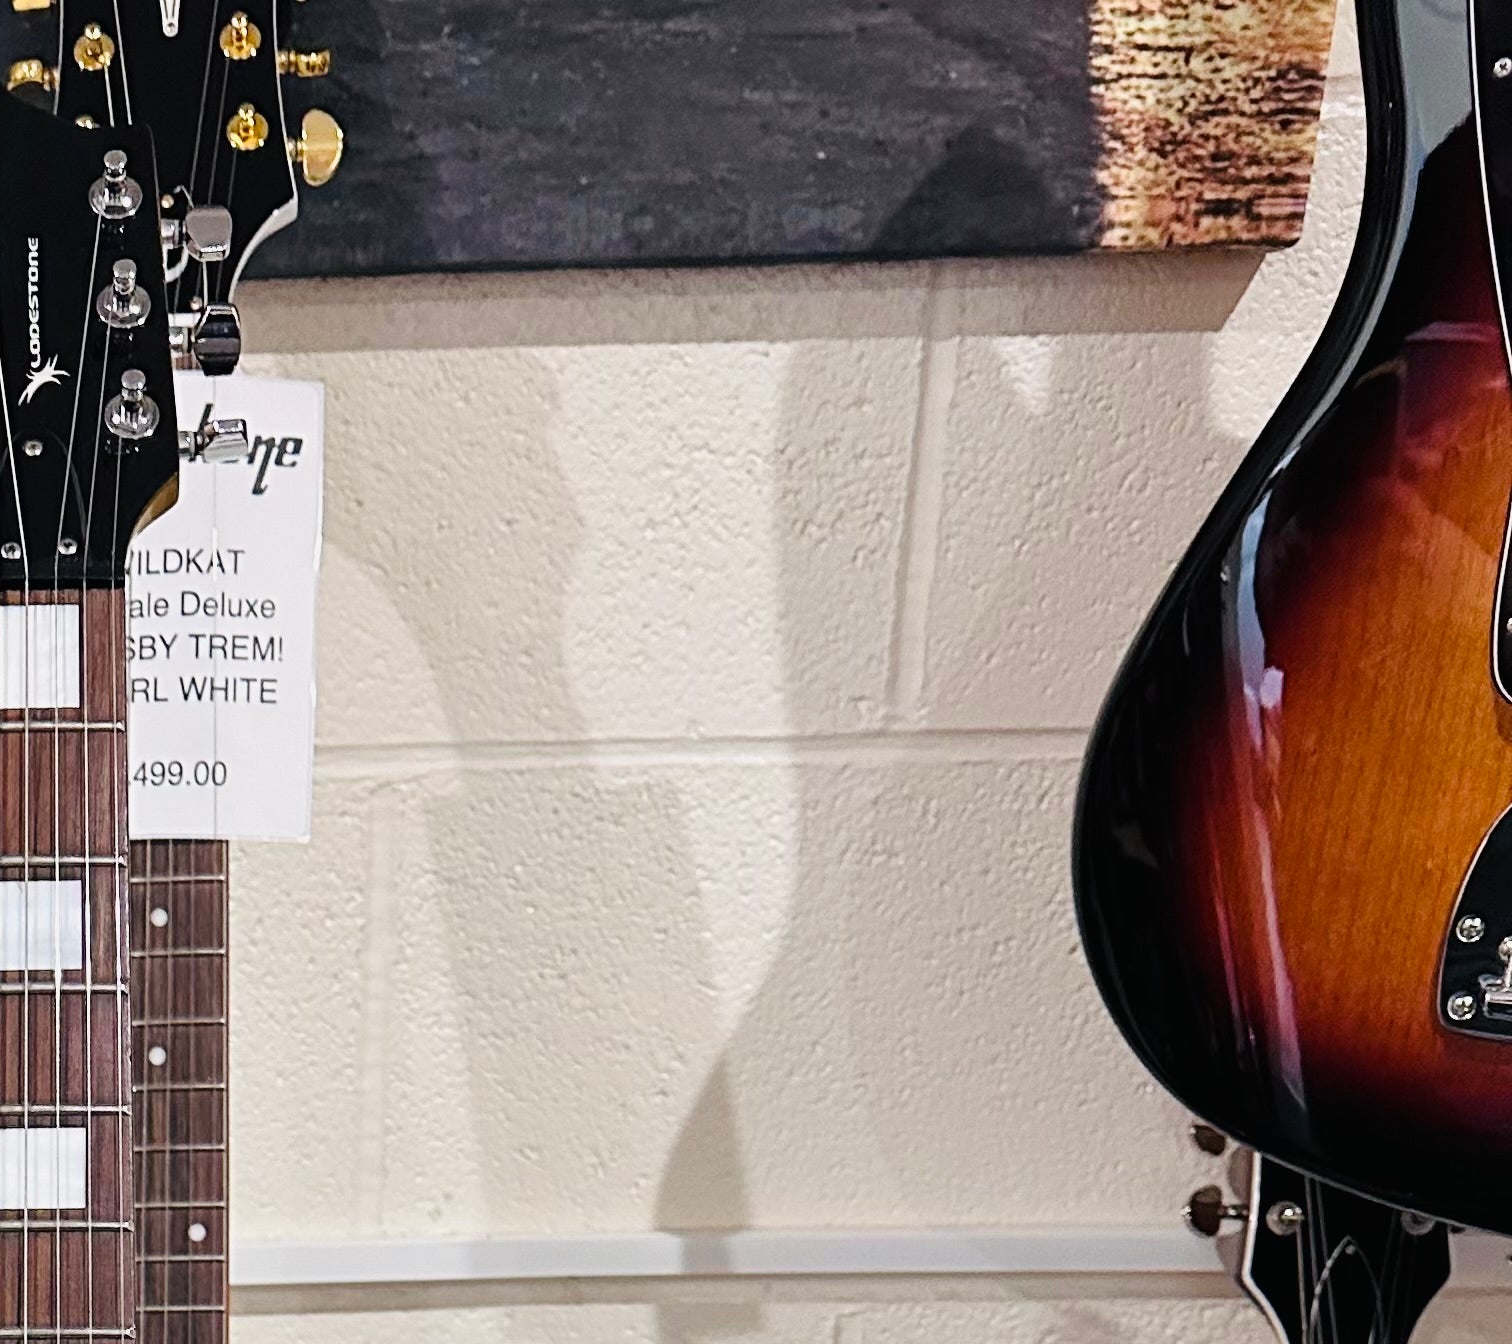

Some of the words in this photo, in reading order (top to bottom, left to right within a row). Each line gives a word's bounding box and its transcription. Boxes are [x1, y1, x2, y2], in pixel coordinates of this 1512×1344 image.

[27, 237, 41, 369] LODESTONE
[125, 548, 246, 576] ILDKAT
[129, 592, 169, 619] ale
[181, 591, 277, 619] Deluxe
[188, 633, 284, 662] TREM!
[130, 677, 169, 703] RL
[180, 677, 278, 704] WHITE
[128, 760, 228, 787] 499.00
